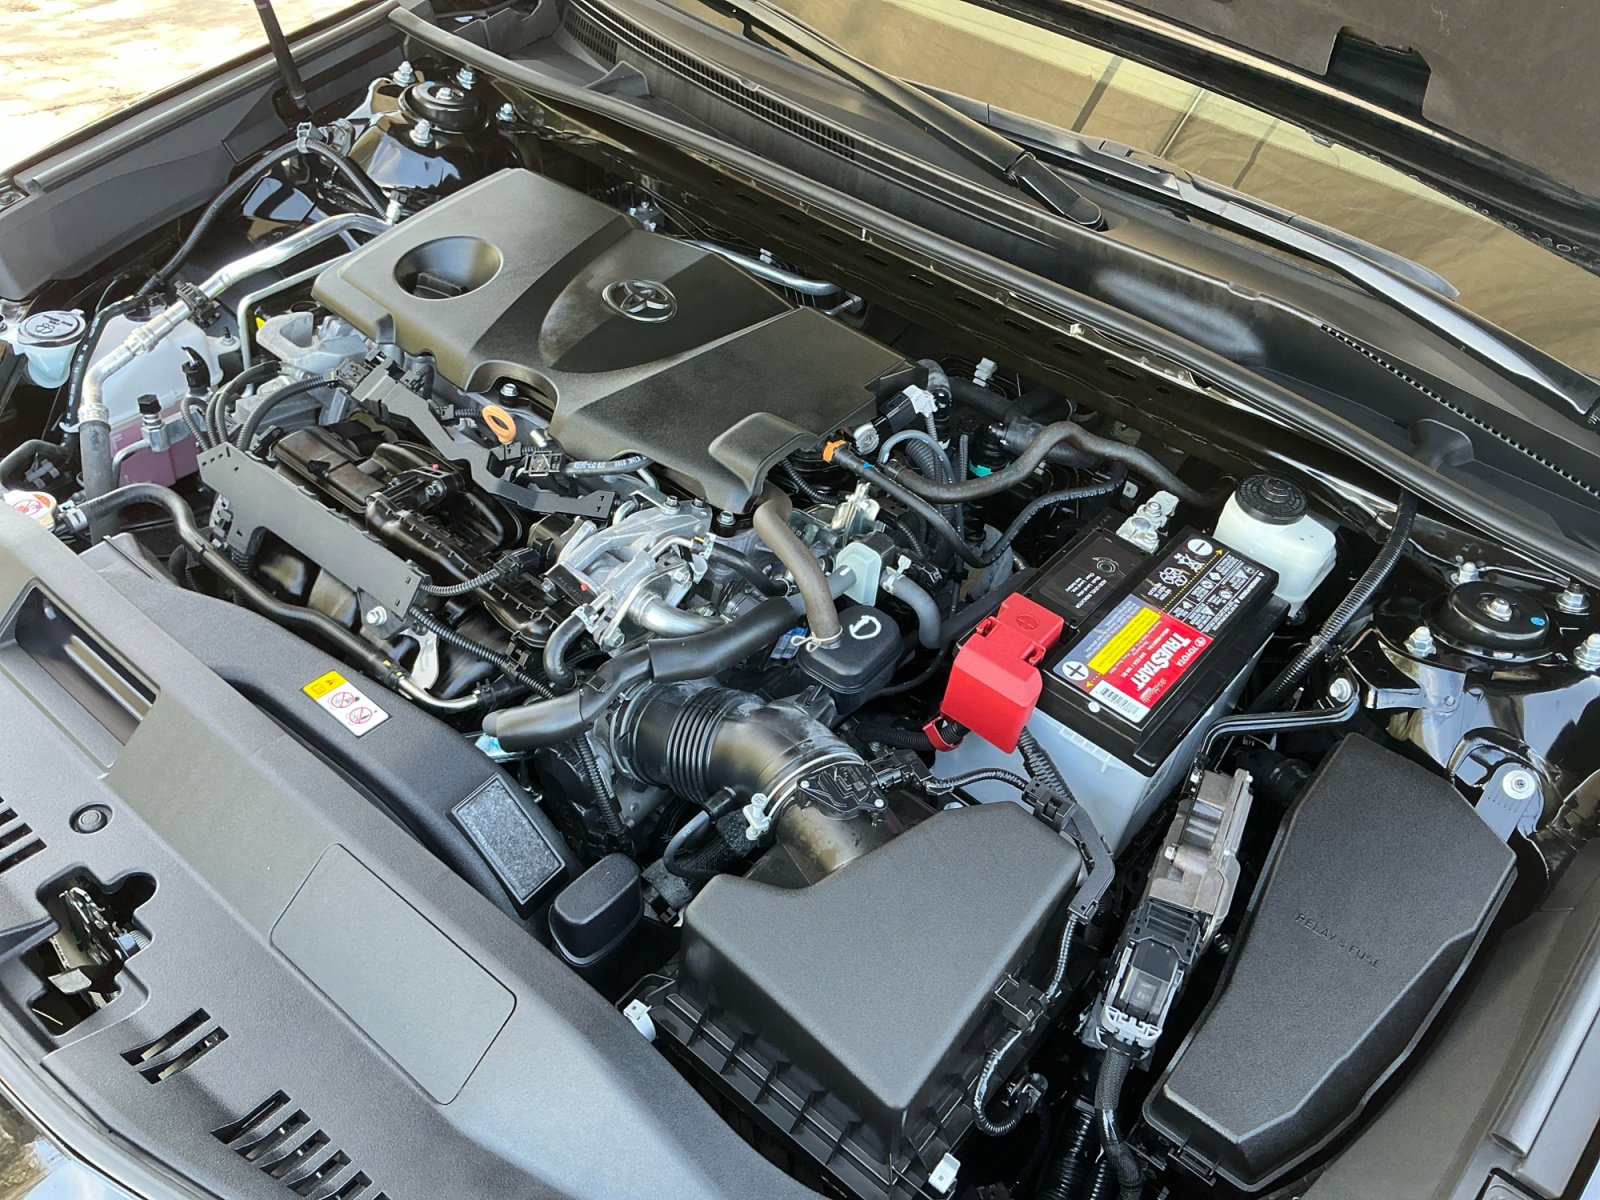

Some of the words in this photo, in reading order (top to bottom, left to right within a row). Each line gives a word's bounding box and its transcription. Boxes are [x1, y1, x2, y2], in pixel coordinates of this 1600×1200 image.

[1175, 644, 1199, 667] TOYOTA
[1295, 913, 1337, 940] RELAY
[1348, 945, 1380, 970] FUSE
